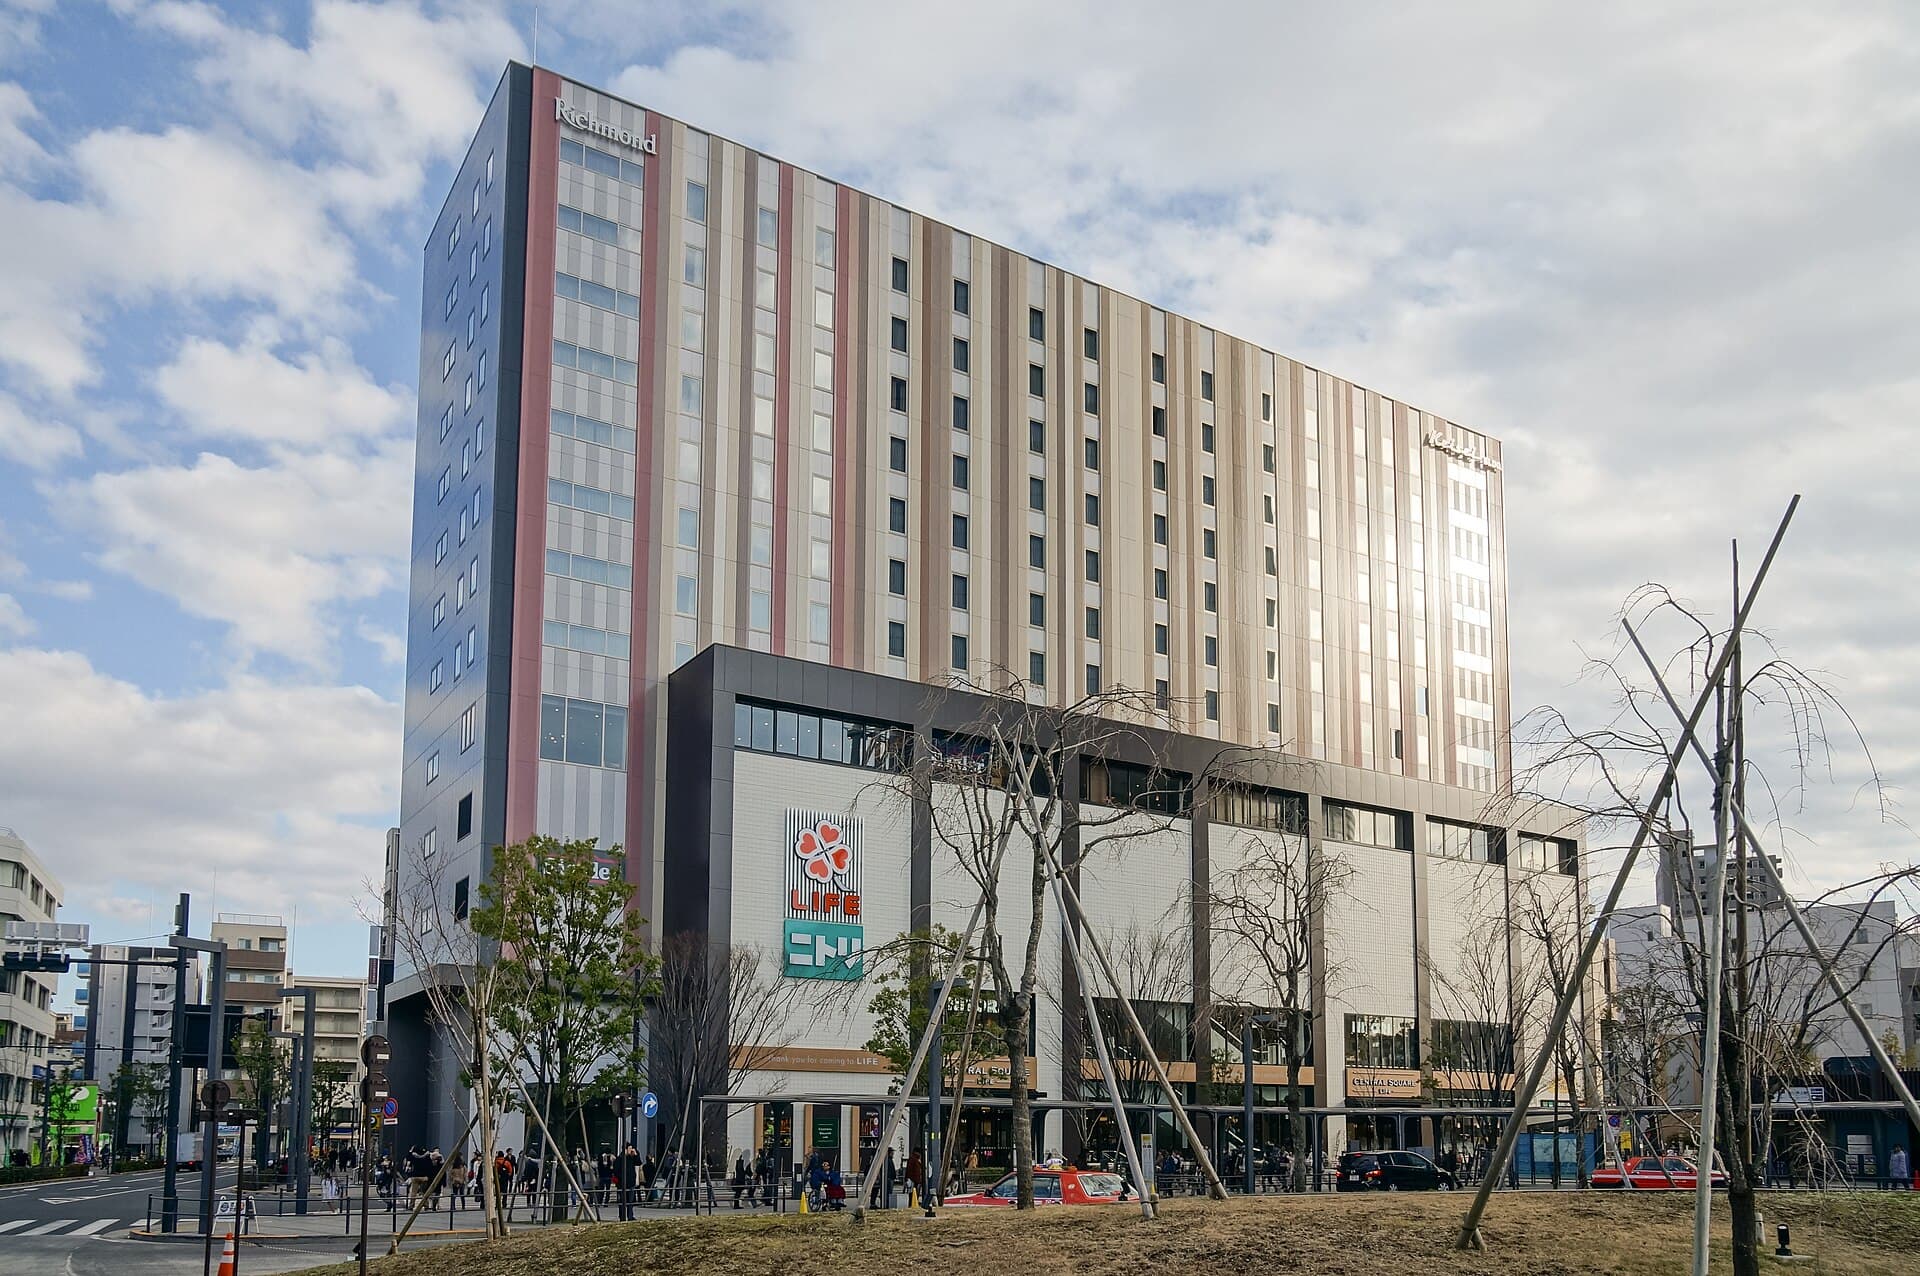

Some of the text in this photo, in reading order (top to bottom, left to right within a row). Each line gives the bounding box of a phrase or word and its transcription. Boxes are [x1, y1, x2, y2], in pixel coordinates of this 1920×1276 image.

[555, 96, 657, 155] Richmond
[791, 888, 860, 916] LIFE
[789, 932, 861, 969] ニトリ
[856, 1057, 879, 1066] LIFE
[1353, 1077, 1417, 1087] CENTRAL SQUARE
